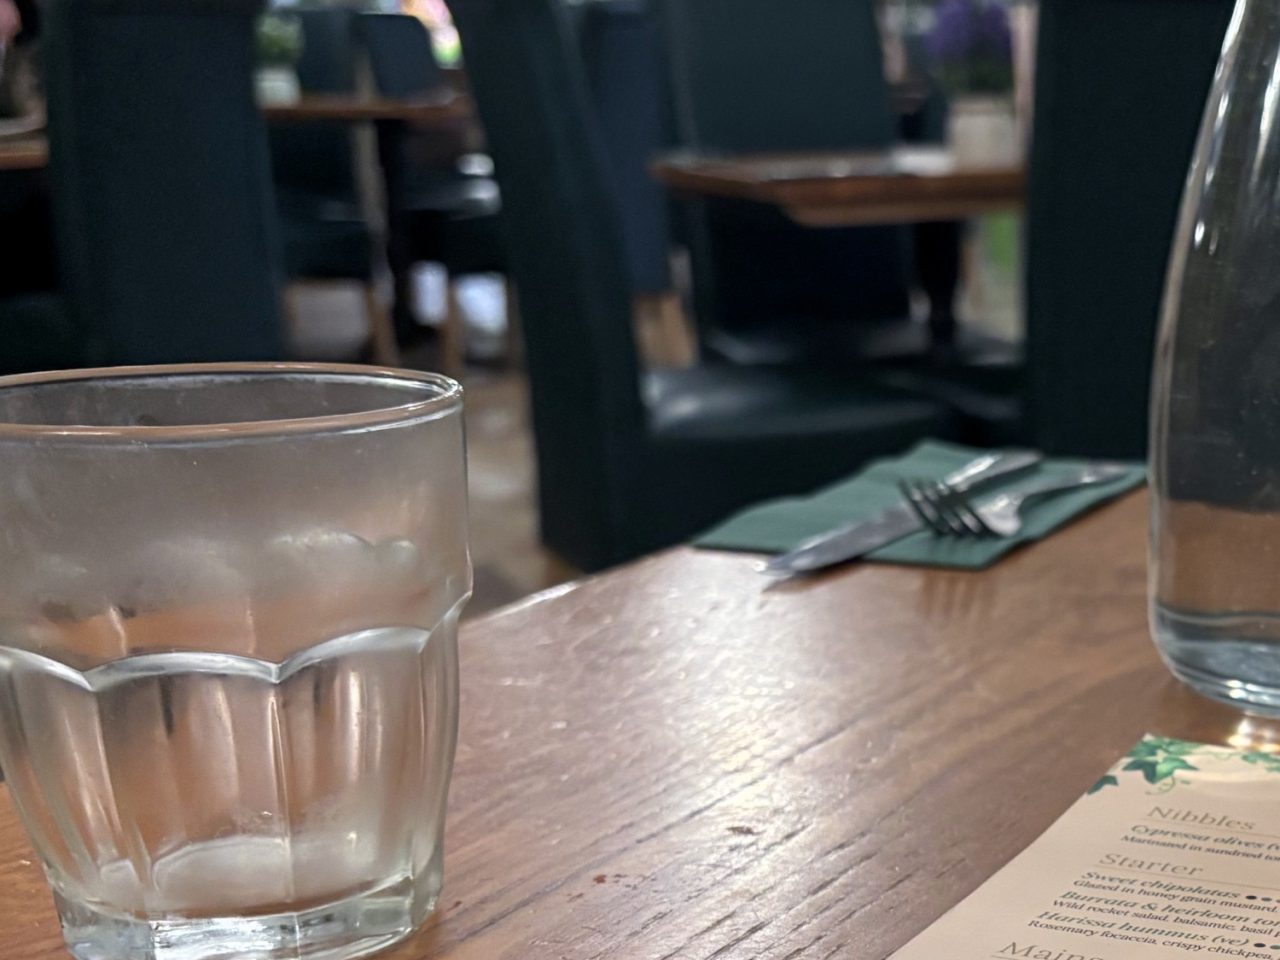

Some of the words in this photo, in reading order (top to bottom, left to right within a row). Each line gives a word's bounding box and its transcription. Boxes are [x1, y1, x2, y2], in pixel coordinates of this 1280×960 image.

[1145, 805, 1255, 831] Nibbles
[1098, 852, 1204, 876] Starter
[1080, 870, 1138, 886] Sweet
[1139, 879, 1241, 899] chipolatas
[1058, 890, 1139, 908] Burrata
[1139, 901, 1158, 912] &
[1159, 903, 1250, 923] heirloom
[1036, 910, 1117, 929] Harissa
[1116, 921, 1209, 941] hummus
[1210, 934, 1250, 947] (ve)
